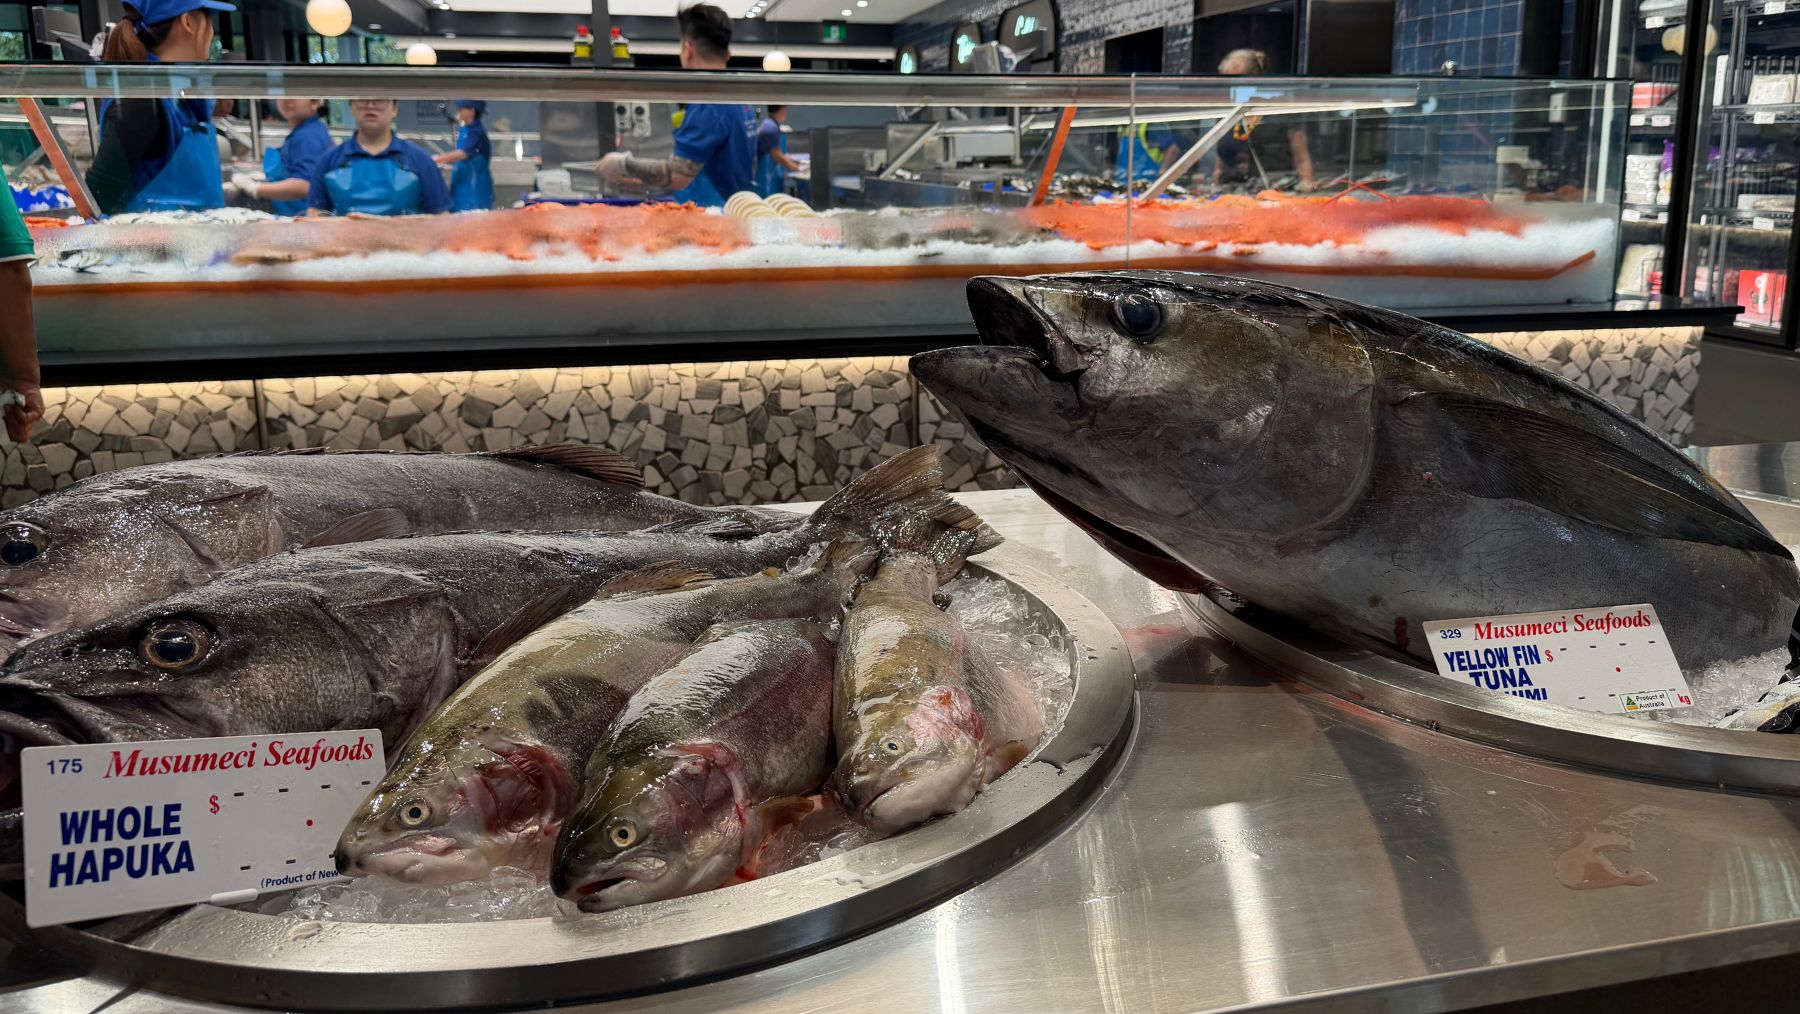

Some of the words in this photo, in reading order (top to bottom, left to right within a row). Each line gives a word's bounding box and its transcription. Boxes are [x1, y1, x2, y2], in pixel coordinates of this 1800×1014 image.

[1440, 629, 1462, 639] 329
[1473, 616, 1567, 640] Musumeci
[1573, 610, 1652, 635] Seafoods
[1443, 647, 1509, 672] YELLOW
[1512, 645, 1541, 666] FIN
[1544, 650, 1554, 662] $
[1469, 668, 1533, 690] TUNA
[1677, 693, 1692, 705] kg
[47, 758, 83, 775] 175
[102, 742, 257, 779] Musumeci
[264, 736, 374, 771] Seafoods
[209, 794, 221, 815] $
[60, 803, 182, 846] WHOLE
[49, 840, 195, 889] HAPUKA
[260, 876, 304, 889] (Product
[306, 871, 317, 881] of
[318, 869, 339, 879] New
